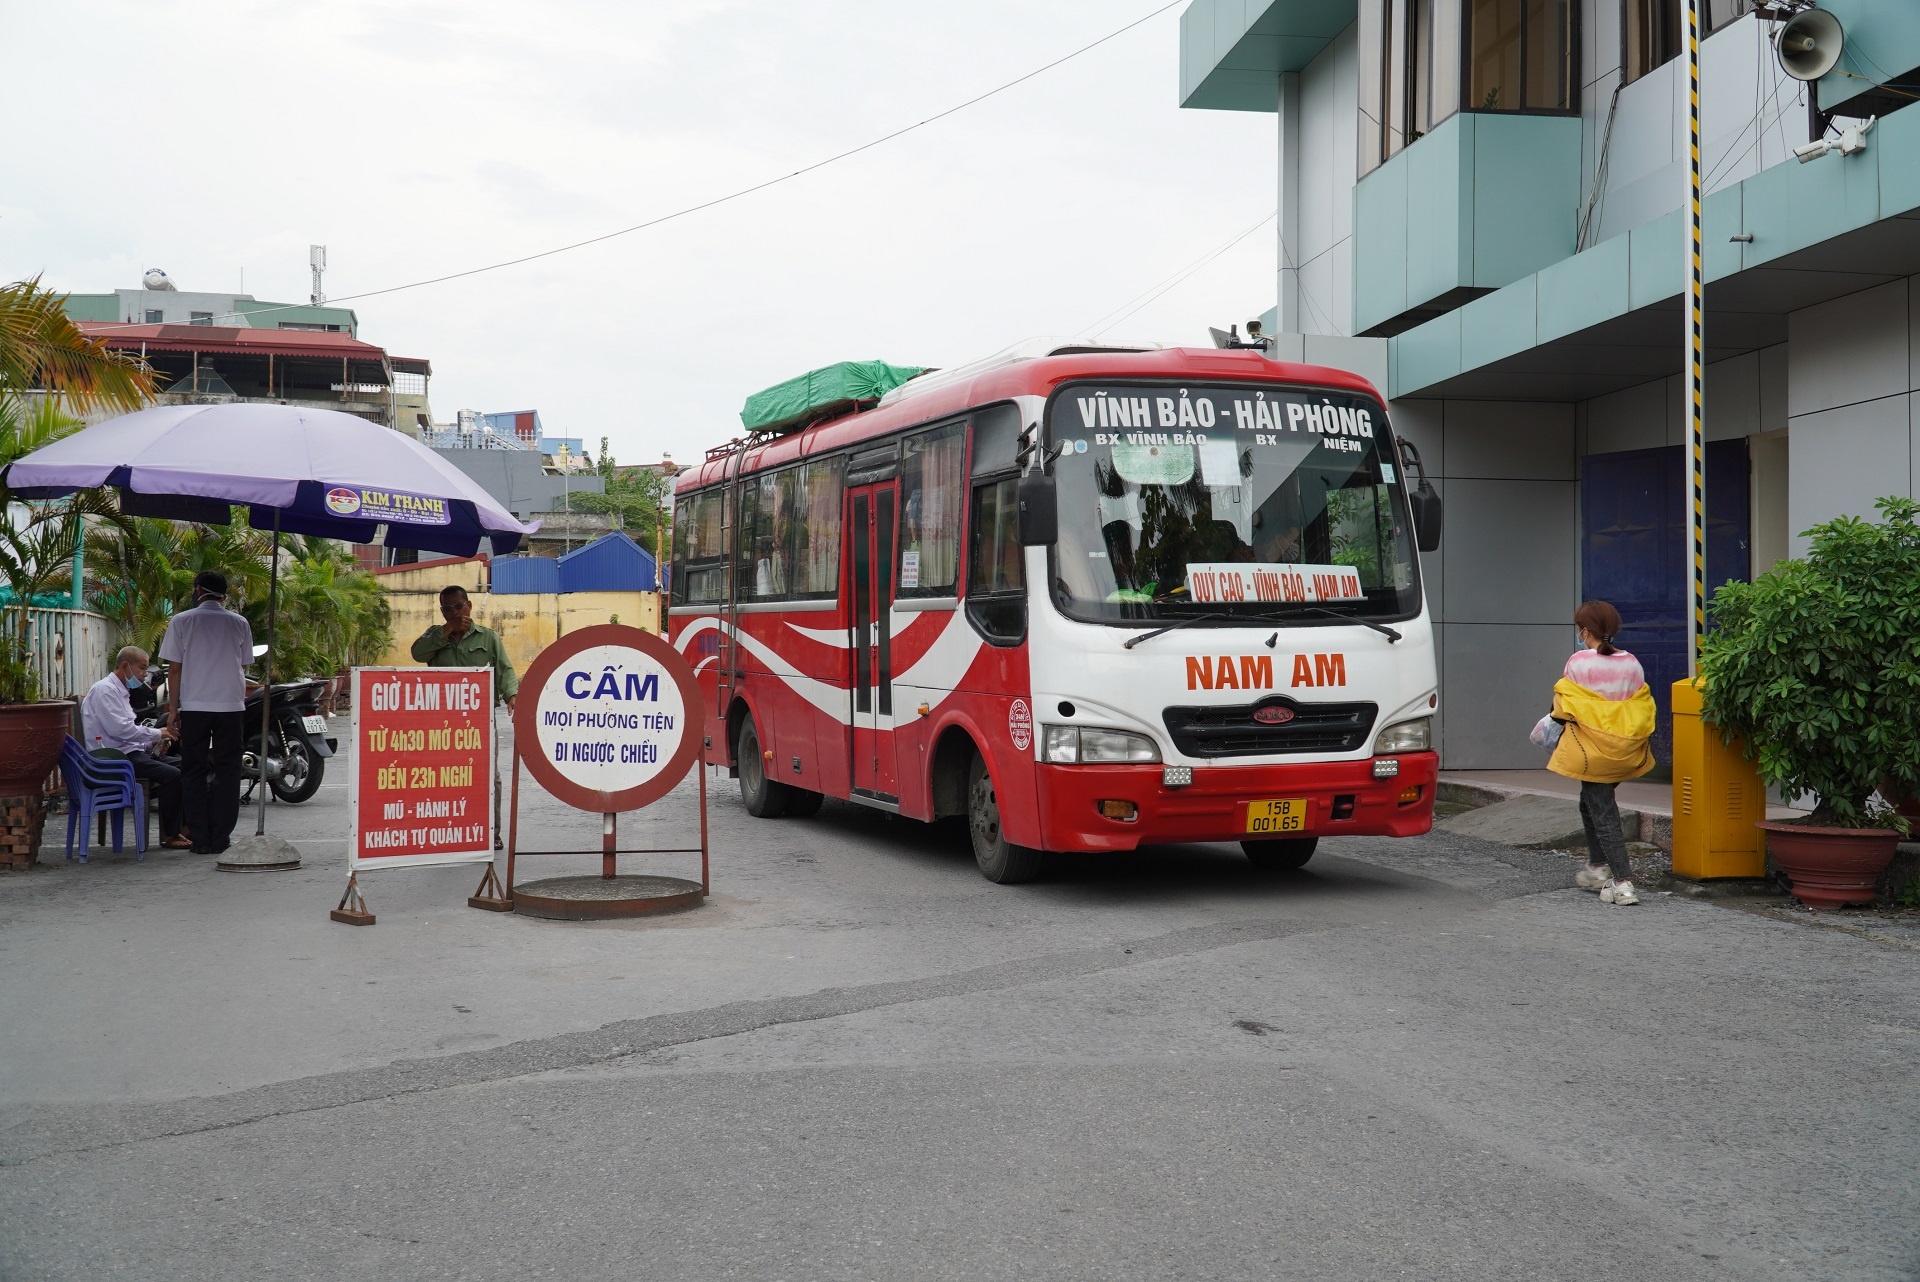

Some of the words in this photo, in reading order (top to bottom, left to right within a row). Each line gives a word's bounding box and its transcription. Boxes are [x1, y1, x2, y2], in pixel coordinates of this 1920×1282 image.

[1077, 390, 1151, 428] VĨNH
[1156, 388, 1216, 428] BẢO
[1234, 391, 1282, 430] HẢI
[1286, 398, 1373, 439] PHÒNG
[1095, 433, 1121, 445] BX
[1126, 430, 1169, 445] VĨNH
[1173, 430, 1208, 446] BẢO
[1256, 434, 1277, 446] BX
[1323, 436, 1362, 453] NIỆM
[361, 490, 390, 507] KIM
[393, 494, 444, 513] THANH
[1193, 566, 1217, 602] QUÝ
[1219, 572, 1244, 602] CAO
[1252, 568, 1282, 602] VĨNH
[1281, 565, 1306, 602] BẢO
[1312, 574, 1340, 602] NAM
[1341, 575, 1359, 598] AM
[565, 664, 659, 702] CẤM
[1185, 655, 1273, 690] NAM
[1291, 654, 1346, 688] AM
[372, 675, 401, 711] GIỜ
[405, 677, 440, 711] LÀM
[445, 677, 480, 716] VIỆC
[369, 724, 389, 752] TỪ
[390, 729, 425, 752] 4h30
[428, 720, 452, 751] MỞ
[454, 719, 482, 750] CỬA
[544, 711, 573, 731] MỌI
[577, 712, 638, 729] PHƯƠNG
[643, 712, 674, 734] TIỆN
[555, 742, 568, 762] ĐI
[572, 741, 615, 767] NGƯỢC
[621, 739, 657, 764] CHIỀU
[377, 760, 407, 790] ĐẾN
[410, 766, 436, 789] 23h
[440, 757, 473, 788] NGHỈ
[383, 799, 404, 820] MŨ
[416, 798, 449, 819] HÀNH
[453, 797, 467, 817] LÝ
[1267, 801, 1291, 815] 15B
[365, 827, 408, 849] KHÁCH
[411, 826, 428, 849] TỰ
[429, 820, 462, 847] QUẢN
[465, 822, 484, 843] LÝ!
[1252, 816, 1300, 831] 001.65
